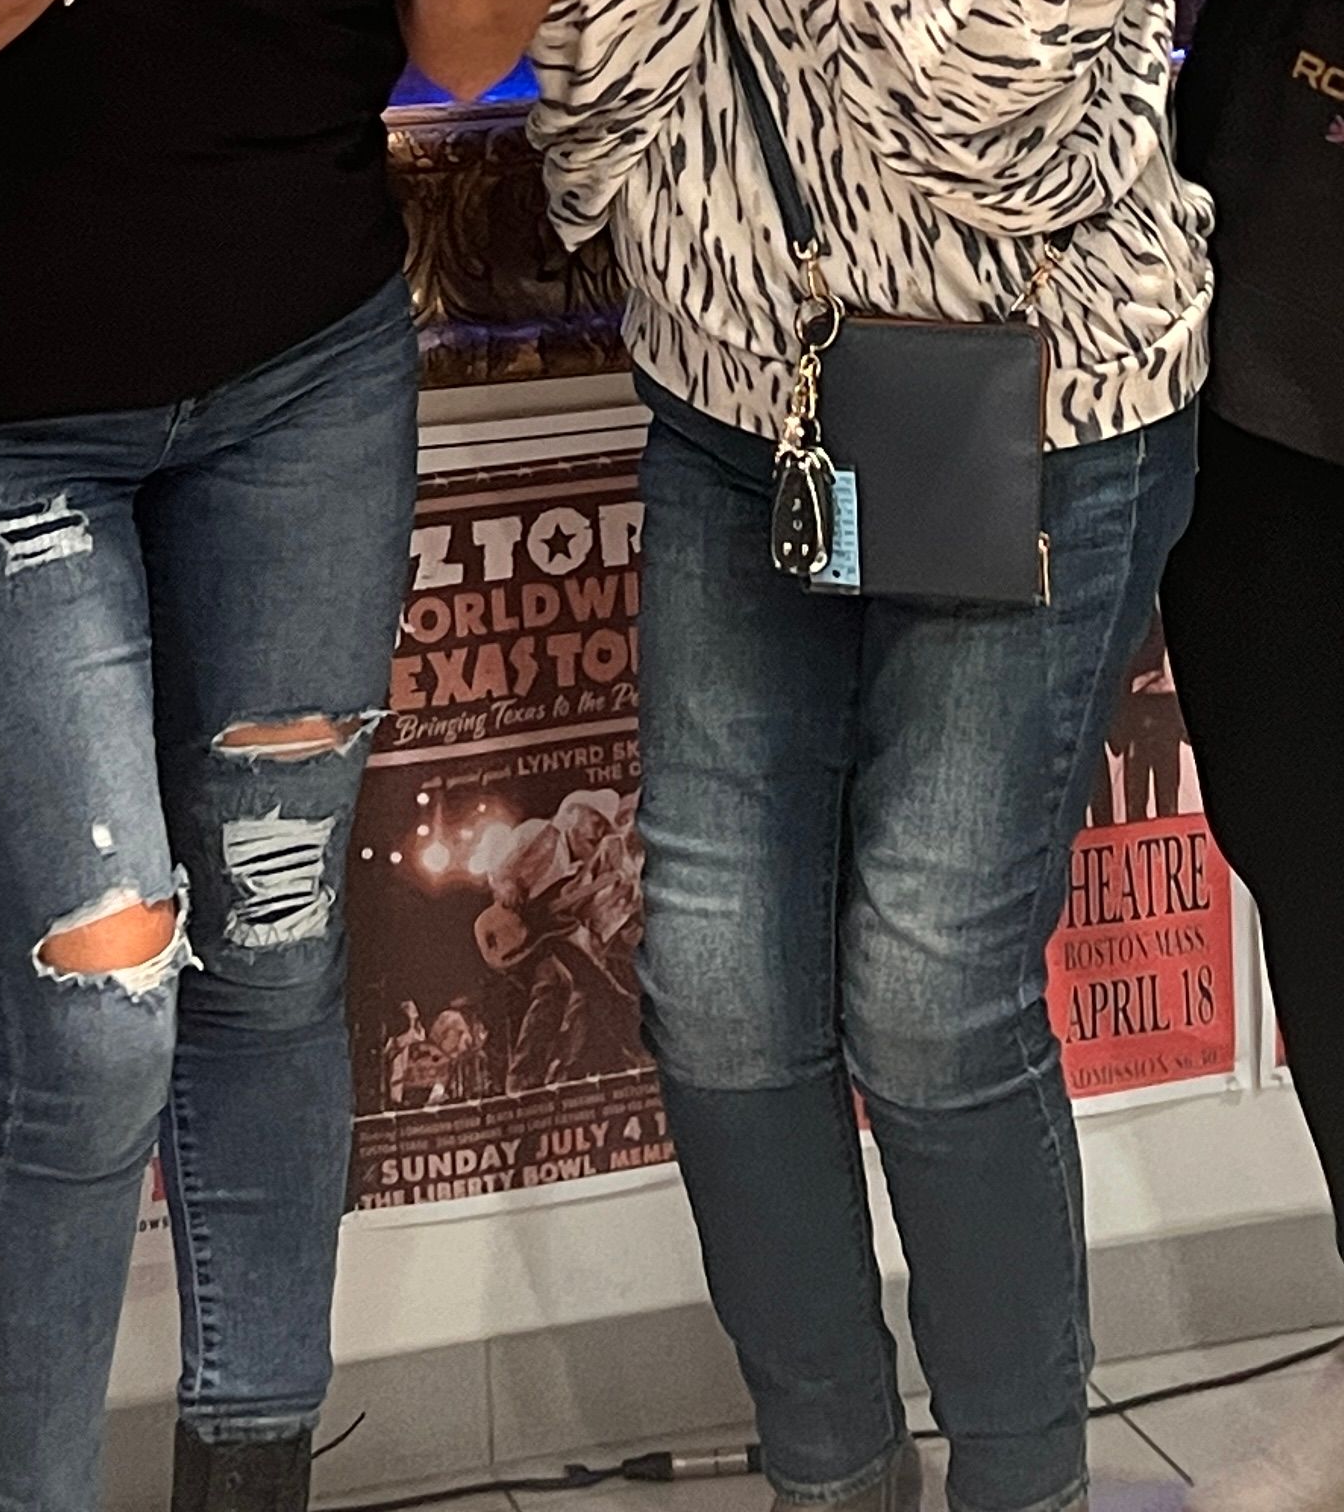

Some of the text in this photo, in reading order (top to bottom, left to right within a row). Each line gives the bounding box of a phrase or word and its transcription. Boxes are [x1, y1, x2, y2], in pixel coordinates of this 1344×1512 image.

[393, 689, 605, 746] Bringing Texas to the
[517, 745, 605, 777] LYNYRD
[586, 763, 623, 784] THE
[1064, 933, 1148, 972] BOSTON
[1066, 964, 1214, 1044] APRIL 18
[381, 1139, 521, 1186] SUNDAY
[535, 1120, 610, 1161] JULY
[622, 1115, 643, 1141] 4
[360, 1188, 406, 1211] THE
[413, 1169, 516, 1205] LIBERTY
[522, 1154, 598, 1187] BOWL
